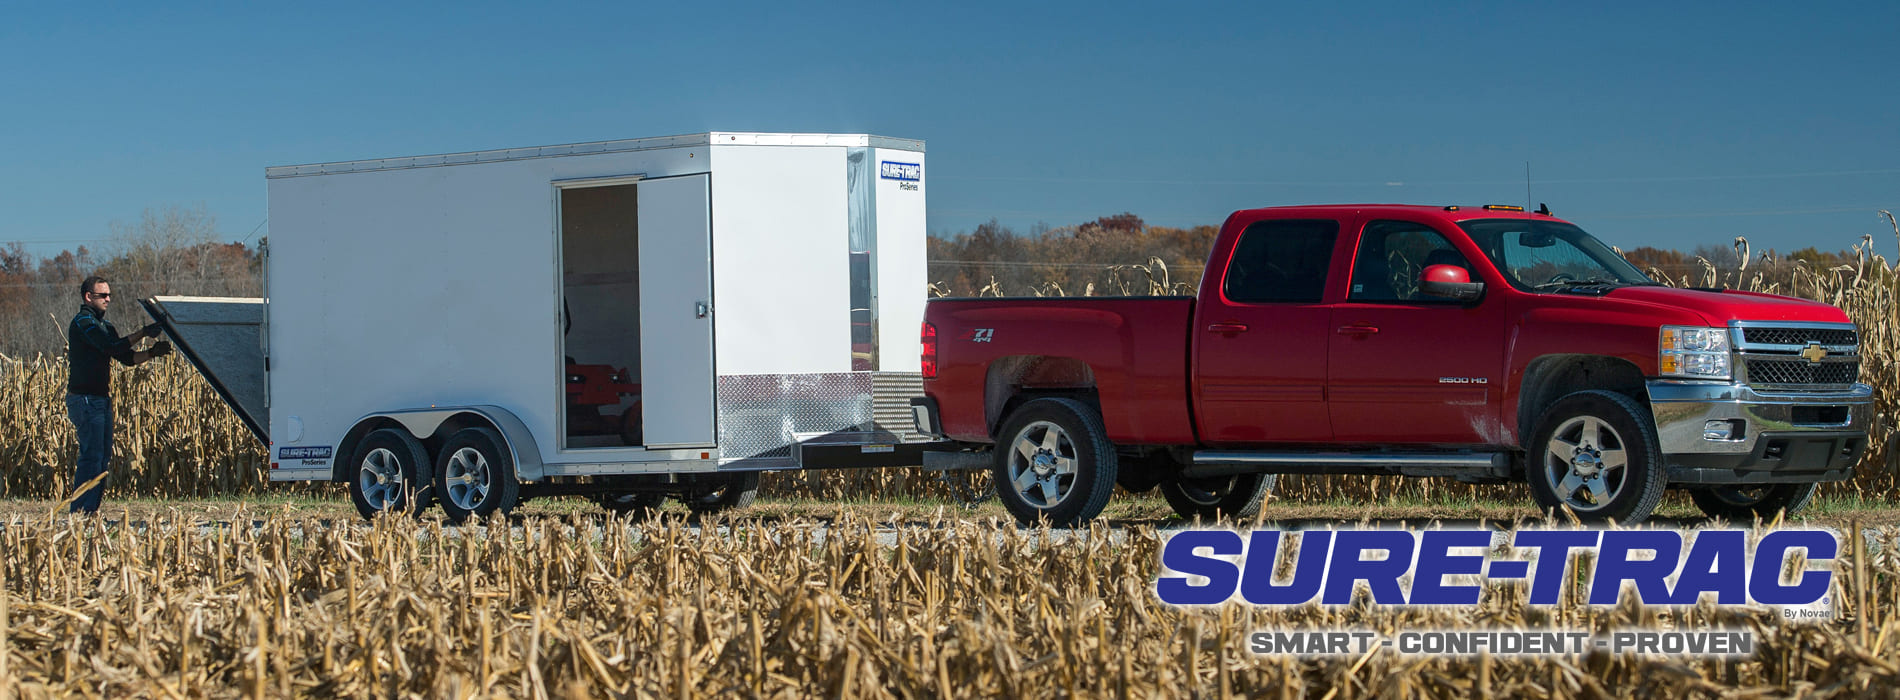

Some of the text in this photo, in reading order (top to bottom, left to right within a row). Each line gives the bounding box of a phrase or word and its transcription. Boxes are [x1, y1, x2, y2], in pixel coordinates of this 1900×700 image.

[882, 163, 920, 179] SURE-TRAC
[900, 182, 918, 191] ProSeries
[280, 447, 331, 458] SURE-TRAC
